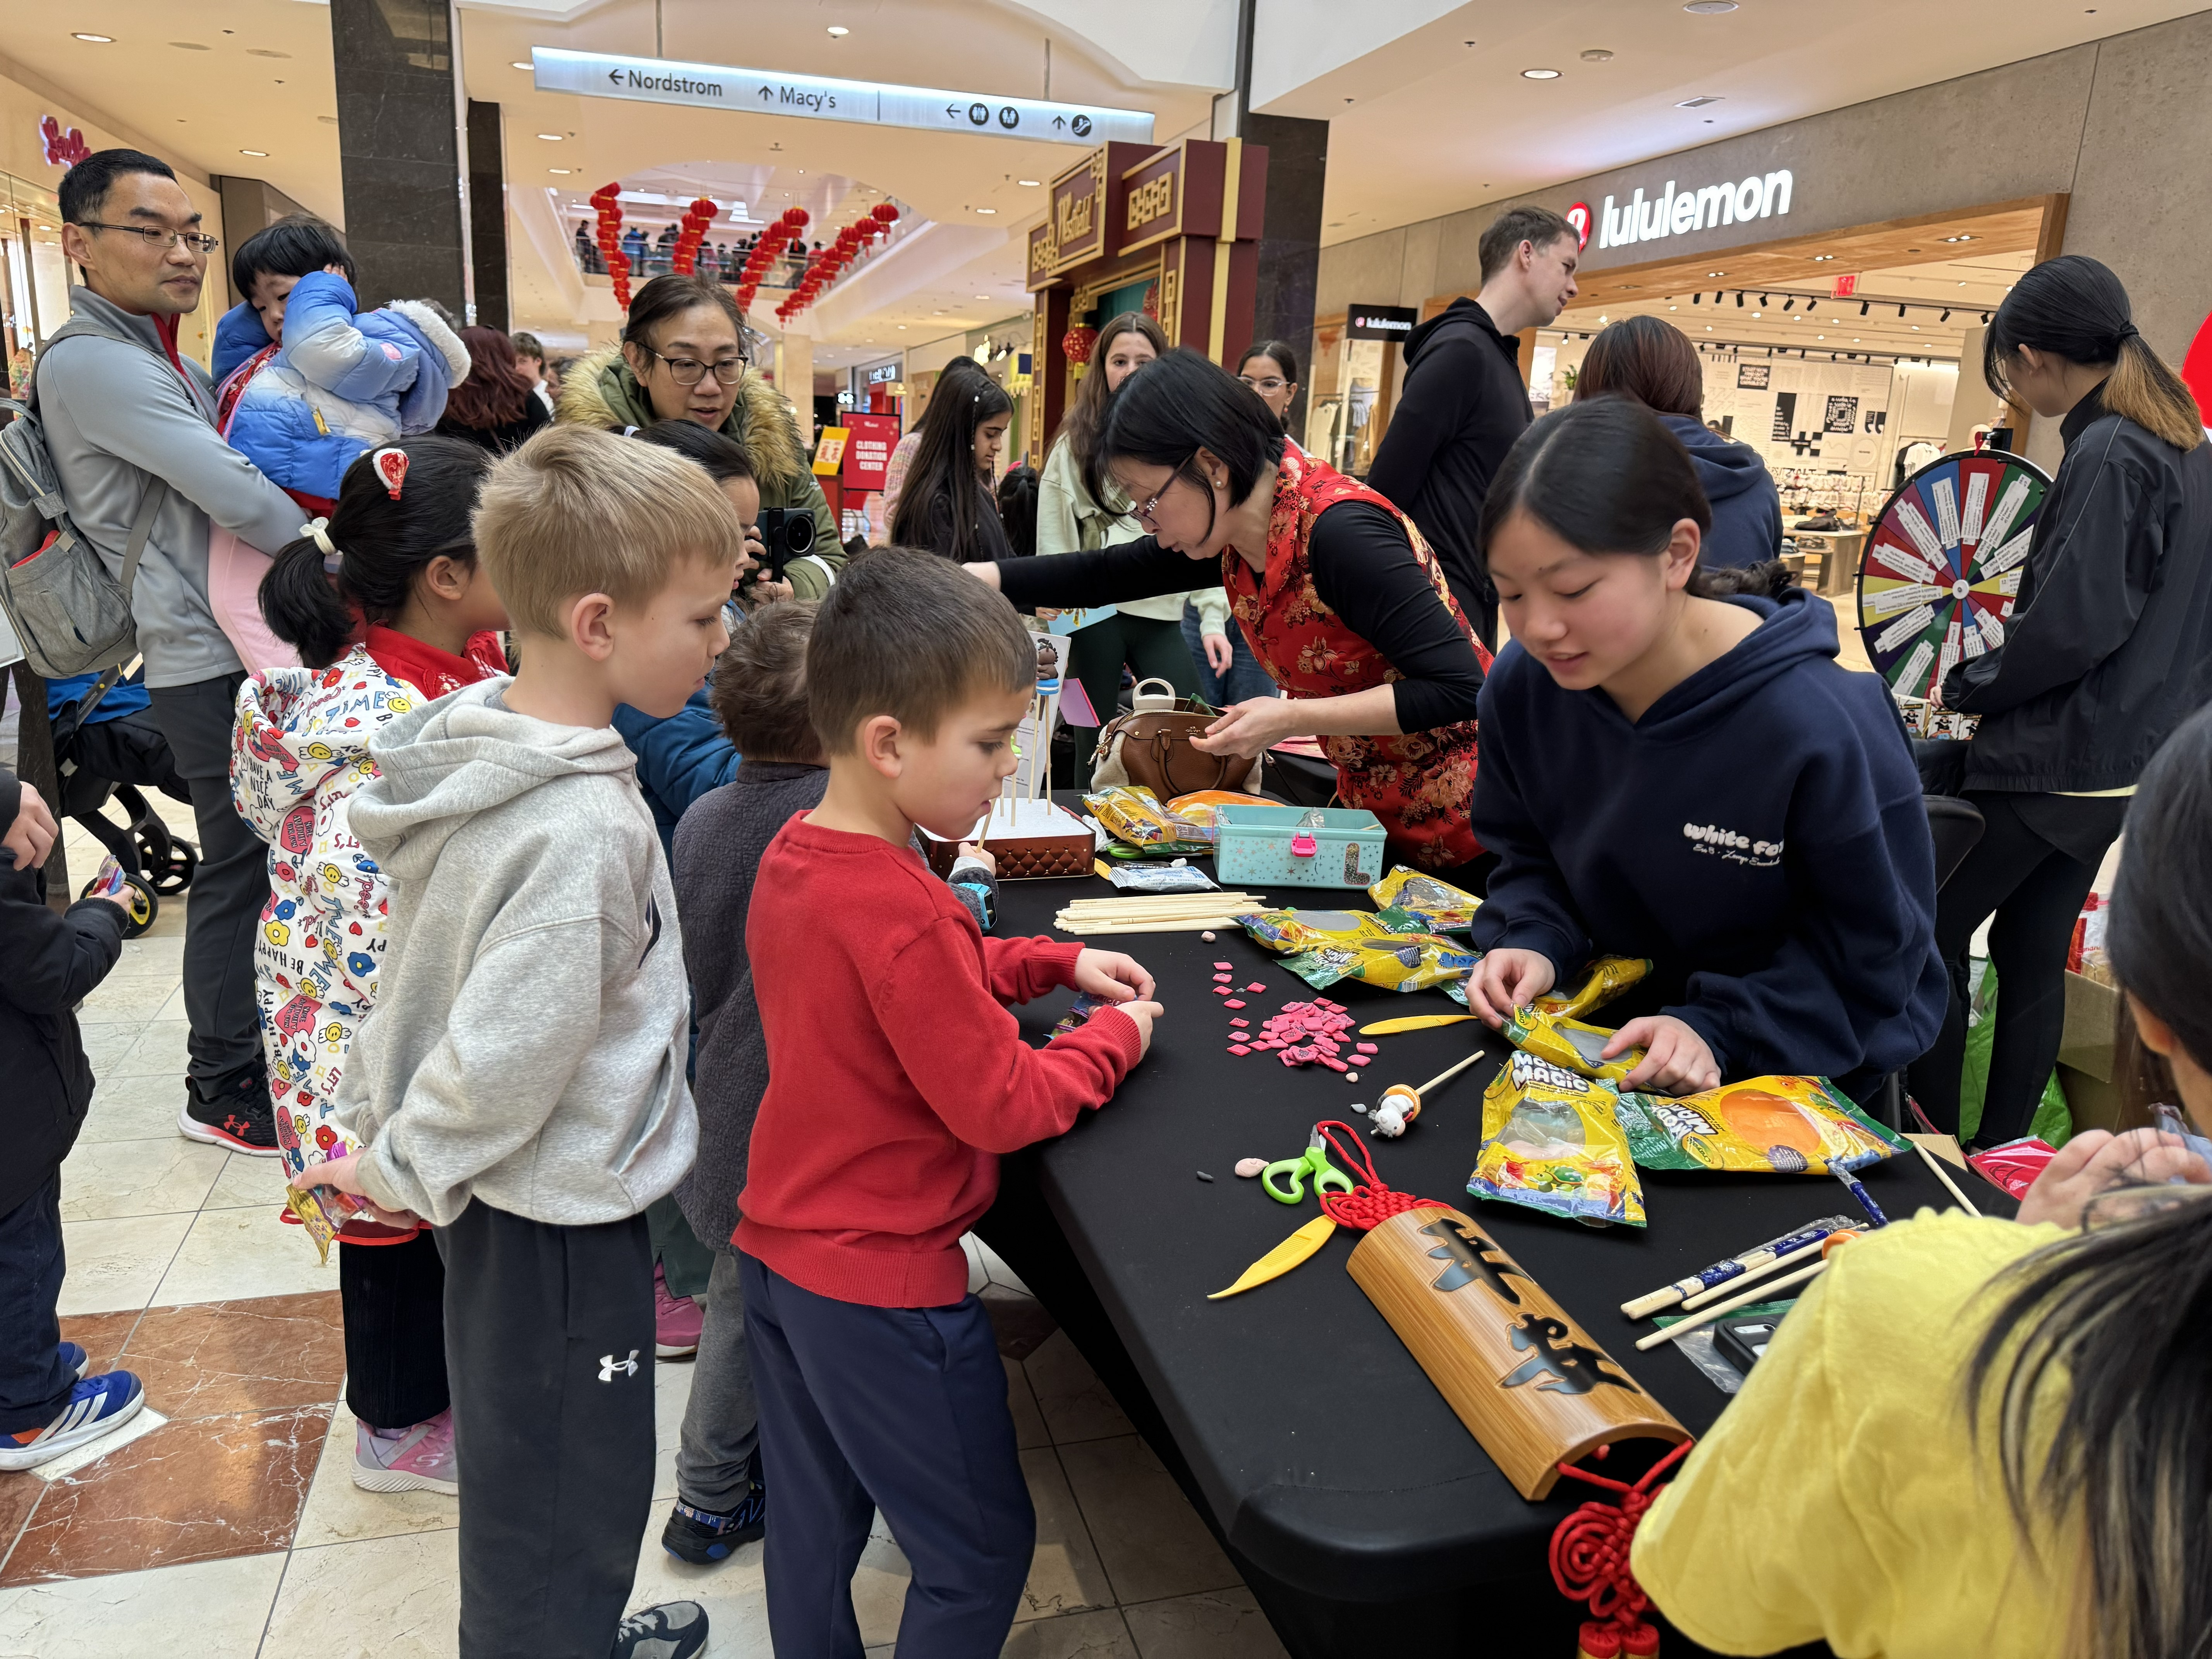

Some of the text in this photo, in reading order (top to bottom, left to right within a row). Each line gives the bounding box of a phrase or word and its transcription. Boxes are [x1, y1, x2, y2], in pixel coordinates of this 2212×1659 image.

[629, 70, 723, 97] Nordstrom
[780, 86, 836, 112] Macy's
[1599, 169, 1793, 249] lululemon
[1366, 317, 1412, 330] lululemon
[856, 440, 887, 451] CLOTHING
[859, 461, 884, 471] CENTER
[249, 756, 272, 783] HAVE A
[250, 778, 268, 797] NICE
[257, 796, 276, 811] DAY
[1683, 823, 1750, 849] white
[258, 939, 304, 975] BE HAPPY
[263, 989, 282, 1057] BE HAPPY
